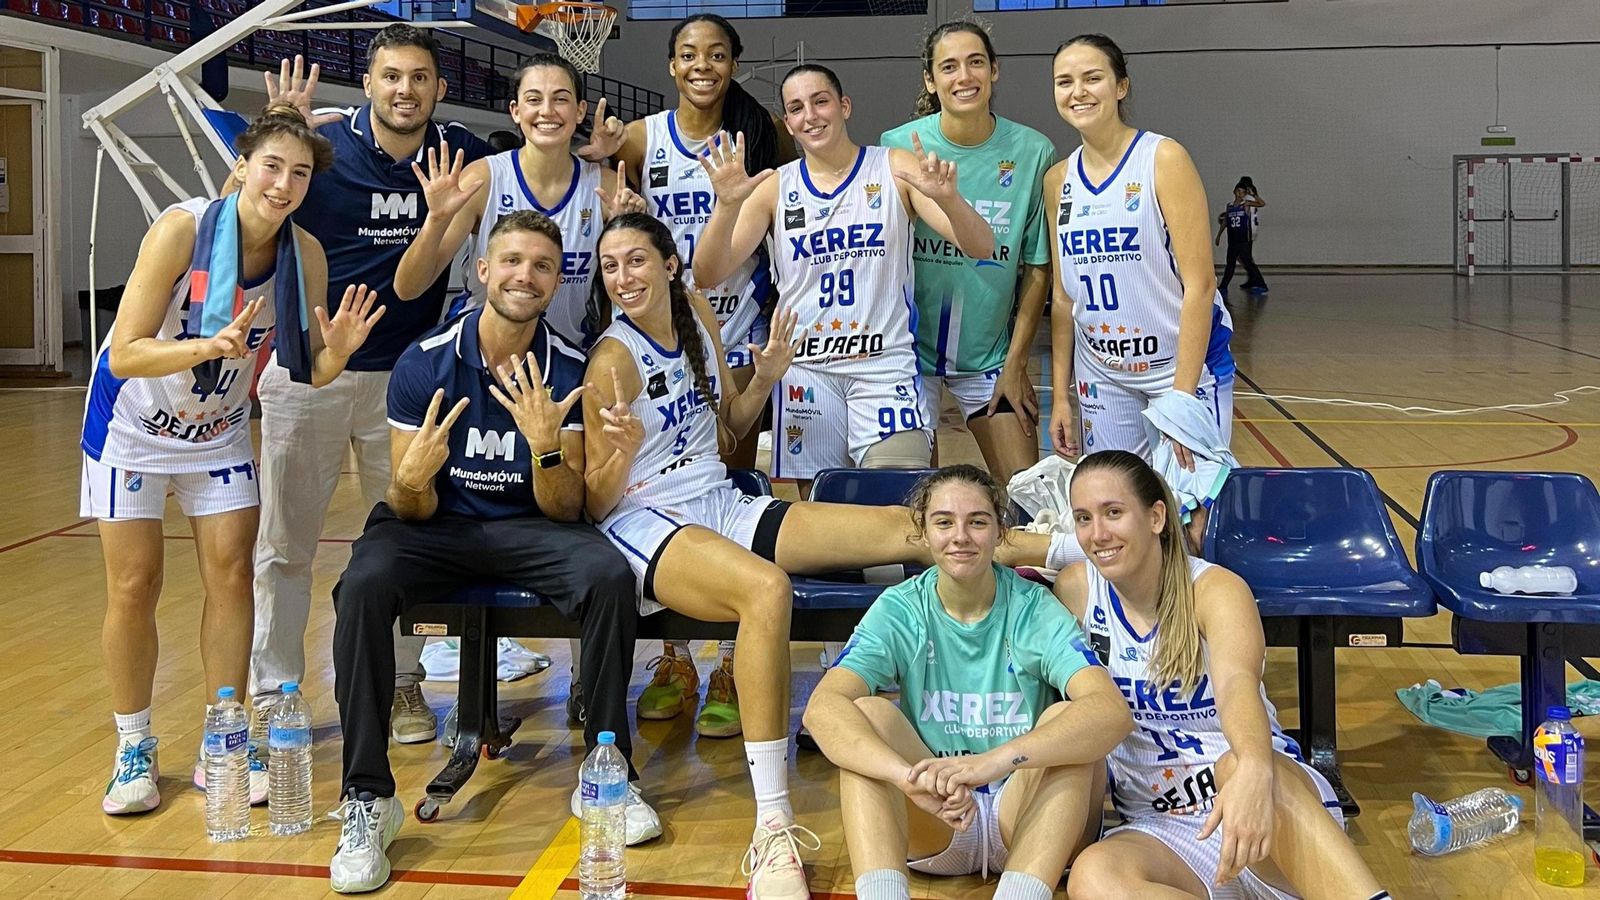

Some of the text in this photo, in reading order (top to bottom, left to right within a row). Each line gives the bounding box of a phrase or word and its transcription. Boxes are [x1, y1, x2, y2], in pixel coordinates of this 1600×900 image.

[652, 190, 717, 218] XER
[673, 216, 696, 225] CLUB
[1230, 216, 1241, 228] 32
[373, 236, 409, 246] Network
[789, 223, 885, 262] XEREZ
[1059, 227, 1140, 257] XEREZ
[834, 250, 886, 262] DEPORTIVO
[1090, 253, 1142, 263] DEPORTIVO
[819, 268, 855, 308] 99
[1080, 273, 1120, 311] 10
[673, 426, 691, 456] 5
[449, 466, 524, 483] MundoMÓVIL
[465, 480, 505, 492] Network
[1112, 673, 1216, 711] EREZ
[920, 690, 1029, 725] XEREZ
[1147, 708, 1217, 721] DEPORTIVO
[966, 725, 1031, 738] DEPORTIVO
[1140, 727, 1204, 762] 14
